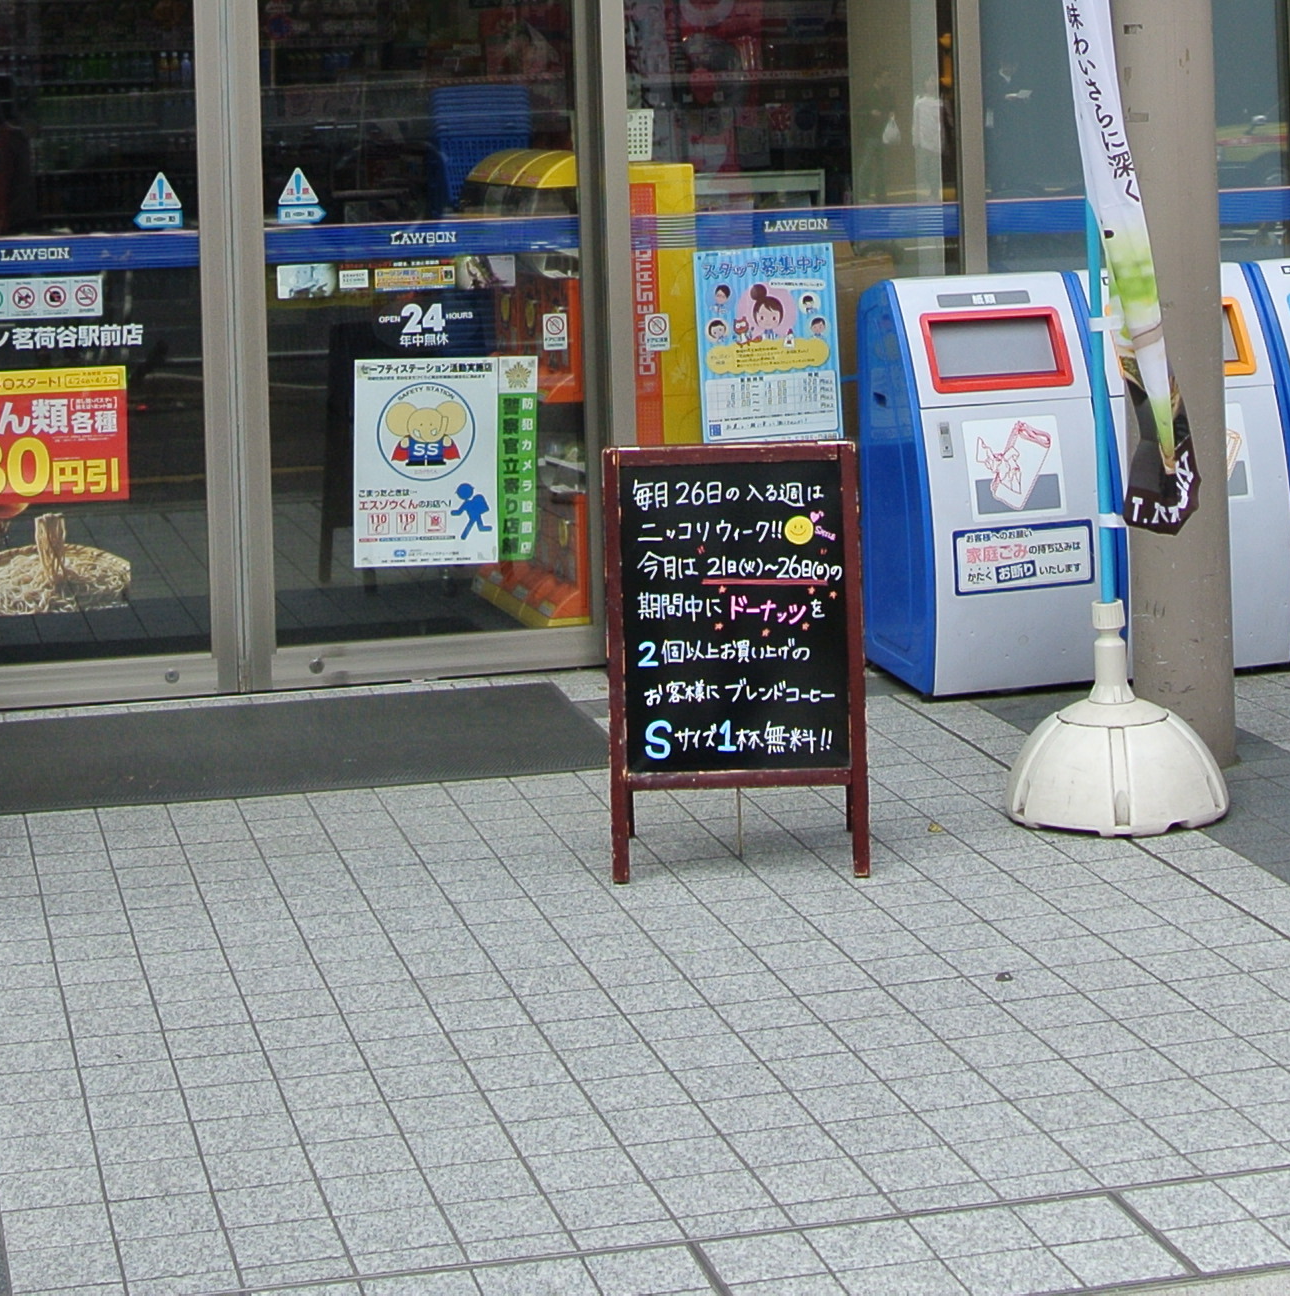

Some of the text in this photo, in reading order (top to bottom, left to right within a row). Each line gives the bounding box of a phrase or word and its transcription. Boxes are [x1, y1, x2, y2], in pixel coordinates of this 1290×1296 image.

[764, 218, 829, 232] LAWSON
[390, 231, 457, 246] LAWSON
[0, 247, 70, 262] LAWSON
[379, 303, 473, 333] OPEN 24 HOURS
[399, 334, 449, 348] 年中無休
[397, 385, 455, 401] SAFETY STATION
[413, 442, 439, 456] SS
[370, 514, 416, 524] 110 119
[966, 531, 1033, 543] お客様へのお願い
[998, 563, 1034, 581] お断り
[1039, 562, 1082, 575] いたします
